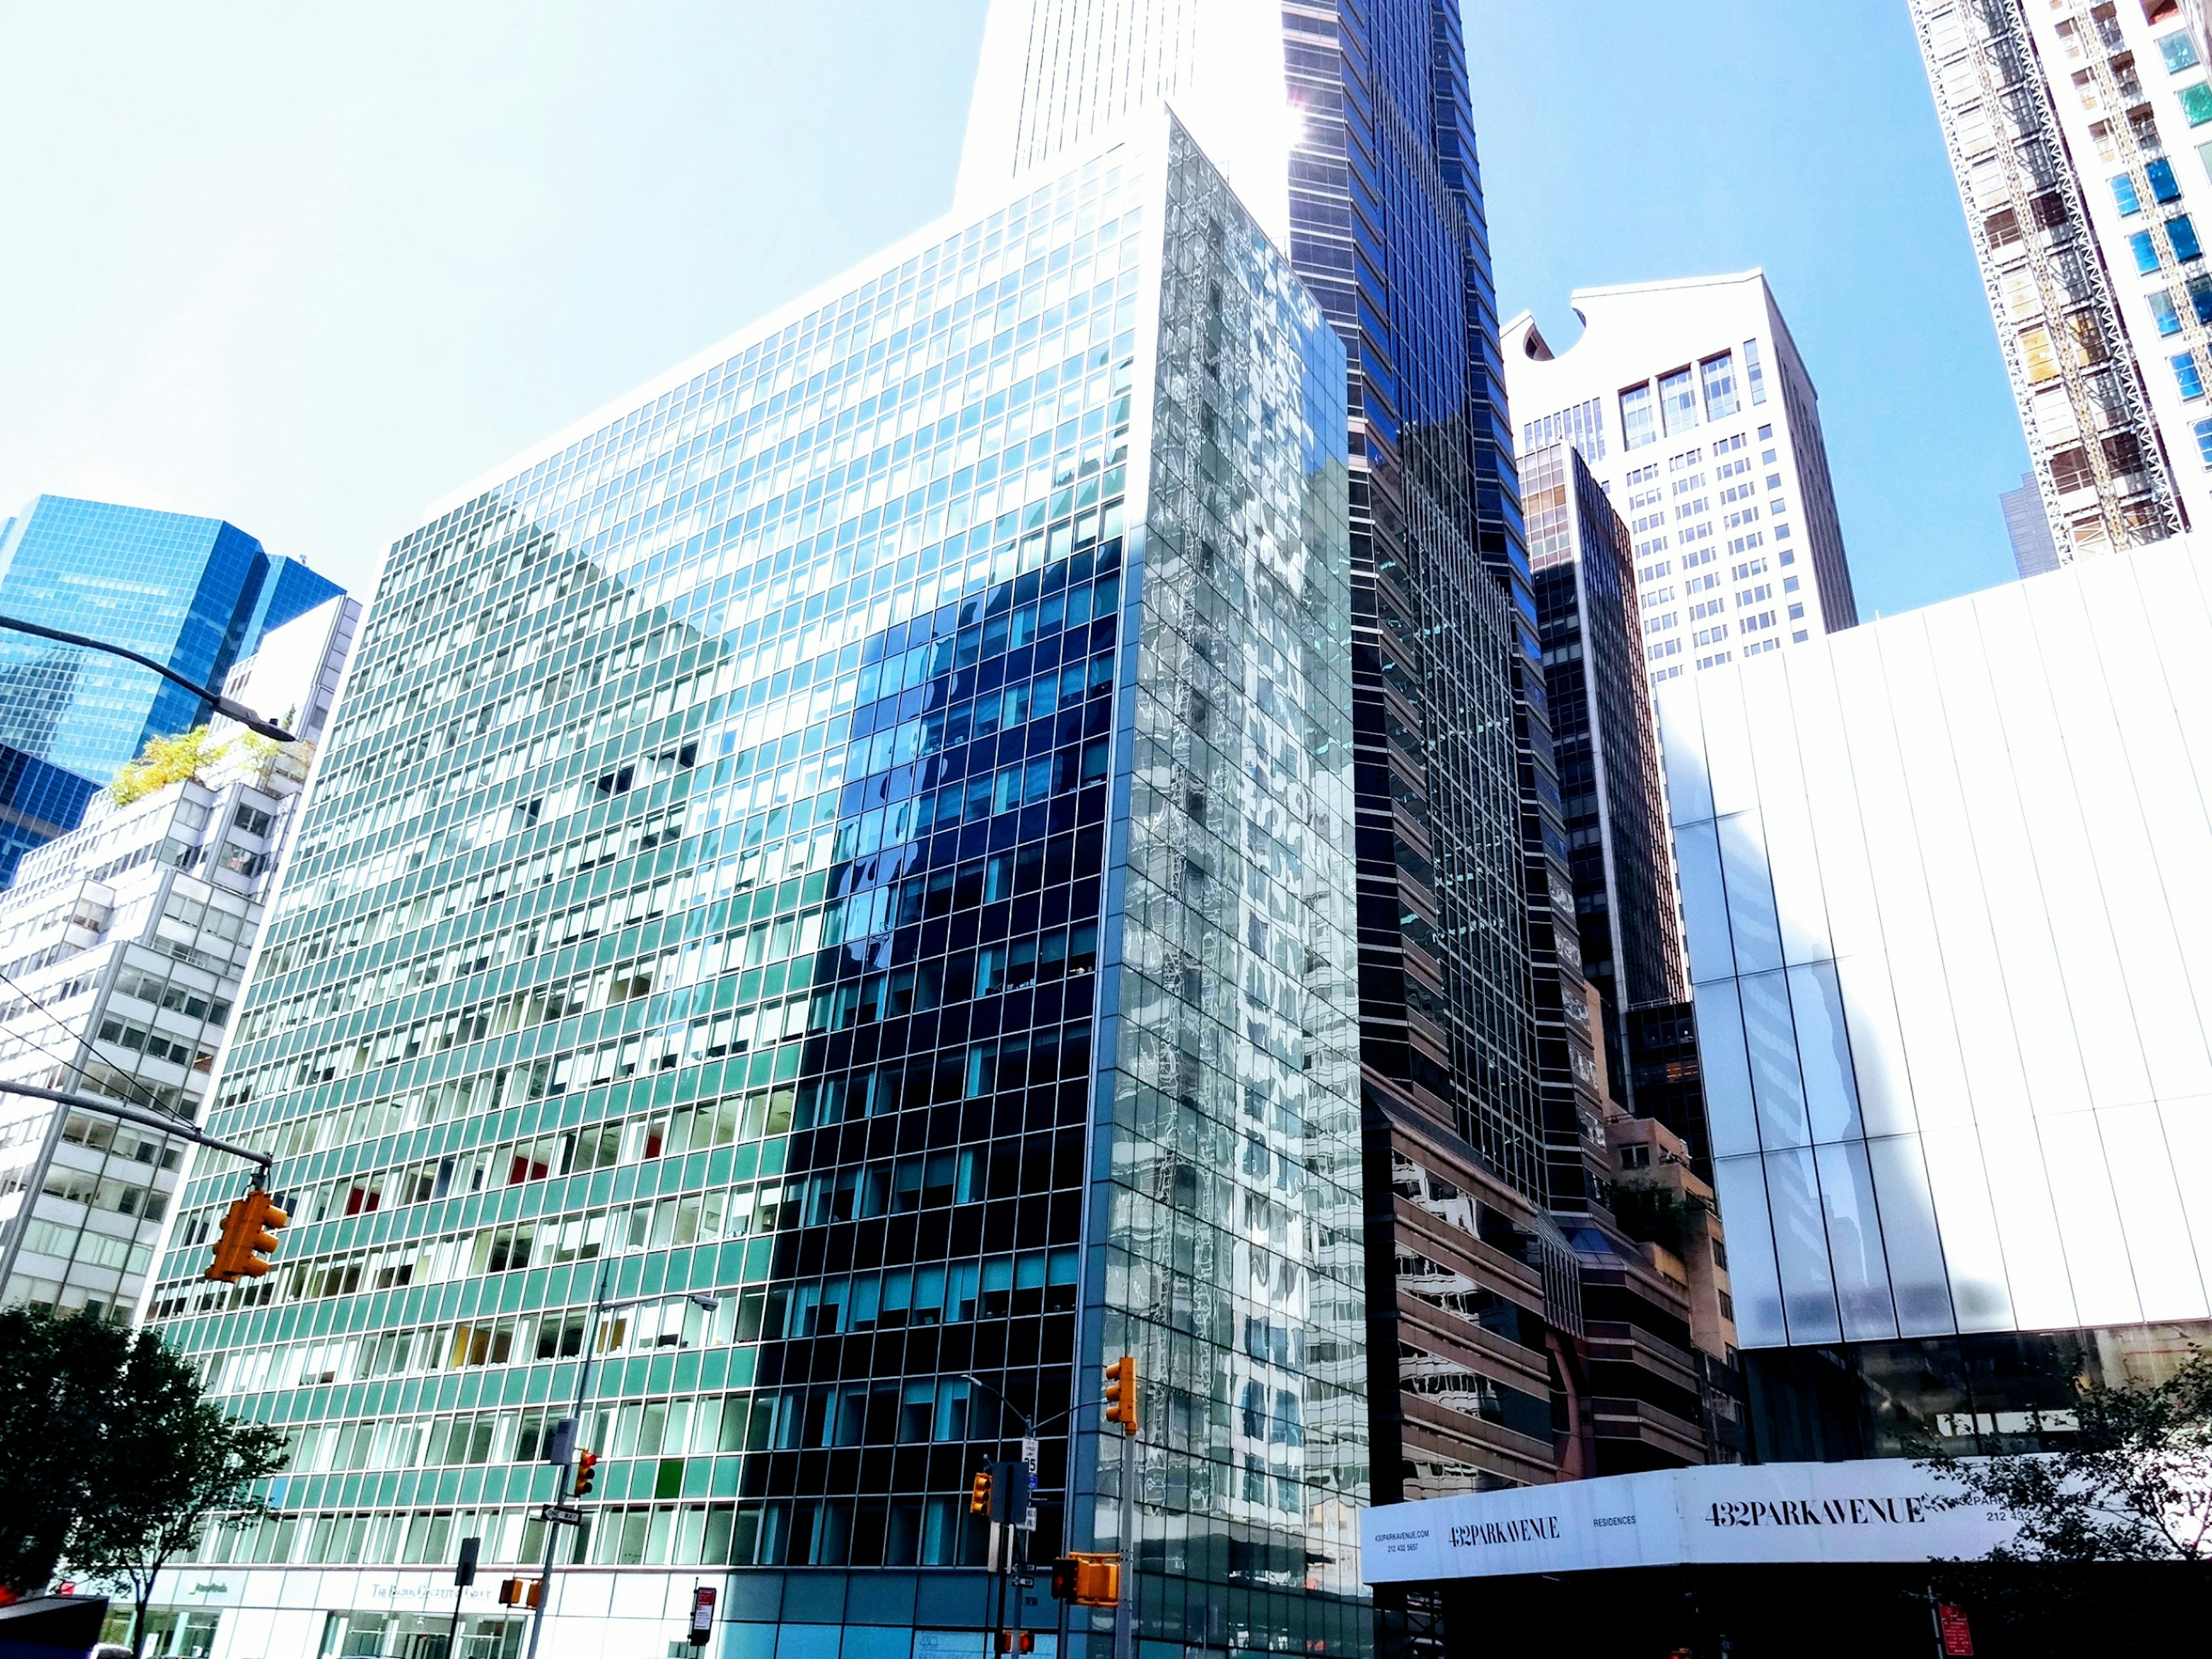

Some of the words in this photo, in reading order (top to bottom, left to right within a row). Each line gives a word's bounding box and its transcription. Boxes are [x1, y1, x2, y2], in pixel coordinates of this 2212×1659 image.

[1705, 1498, 1925, 1527] 432PARKAVENUE
[1986, 1512, 2006, 1521] 212
[1593, 1516, 1637, 1528] RESIDENCES
[1374, 1529, 1430, 1542] 432PARKAVENUE.COM
[1448, 1516, 1560, 1547] 432PARKAVENUE
[1388, 1544, 1396, 1552] 212
[1397, 1544, 1406, 1552] 432
